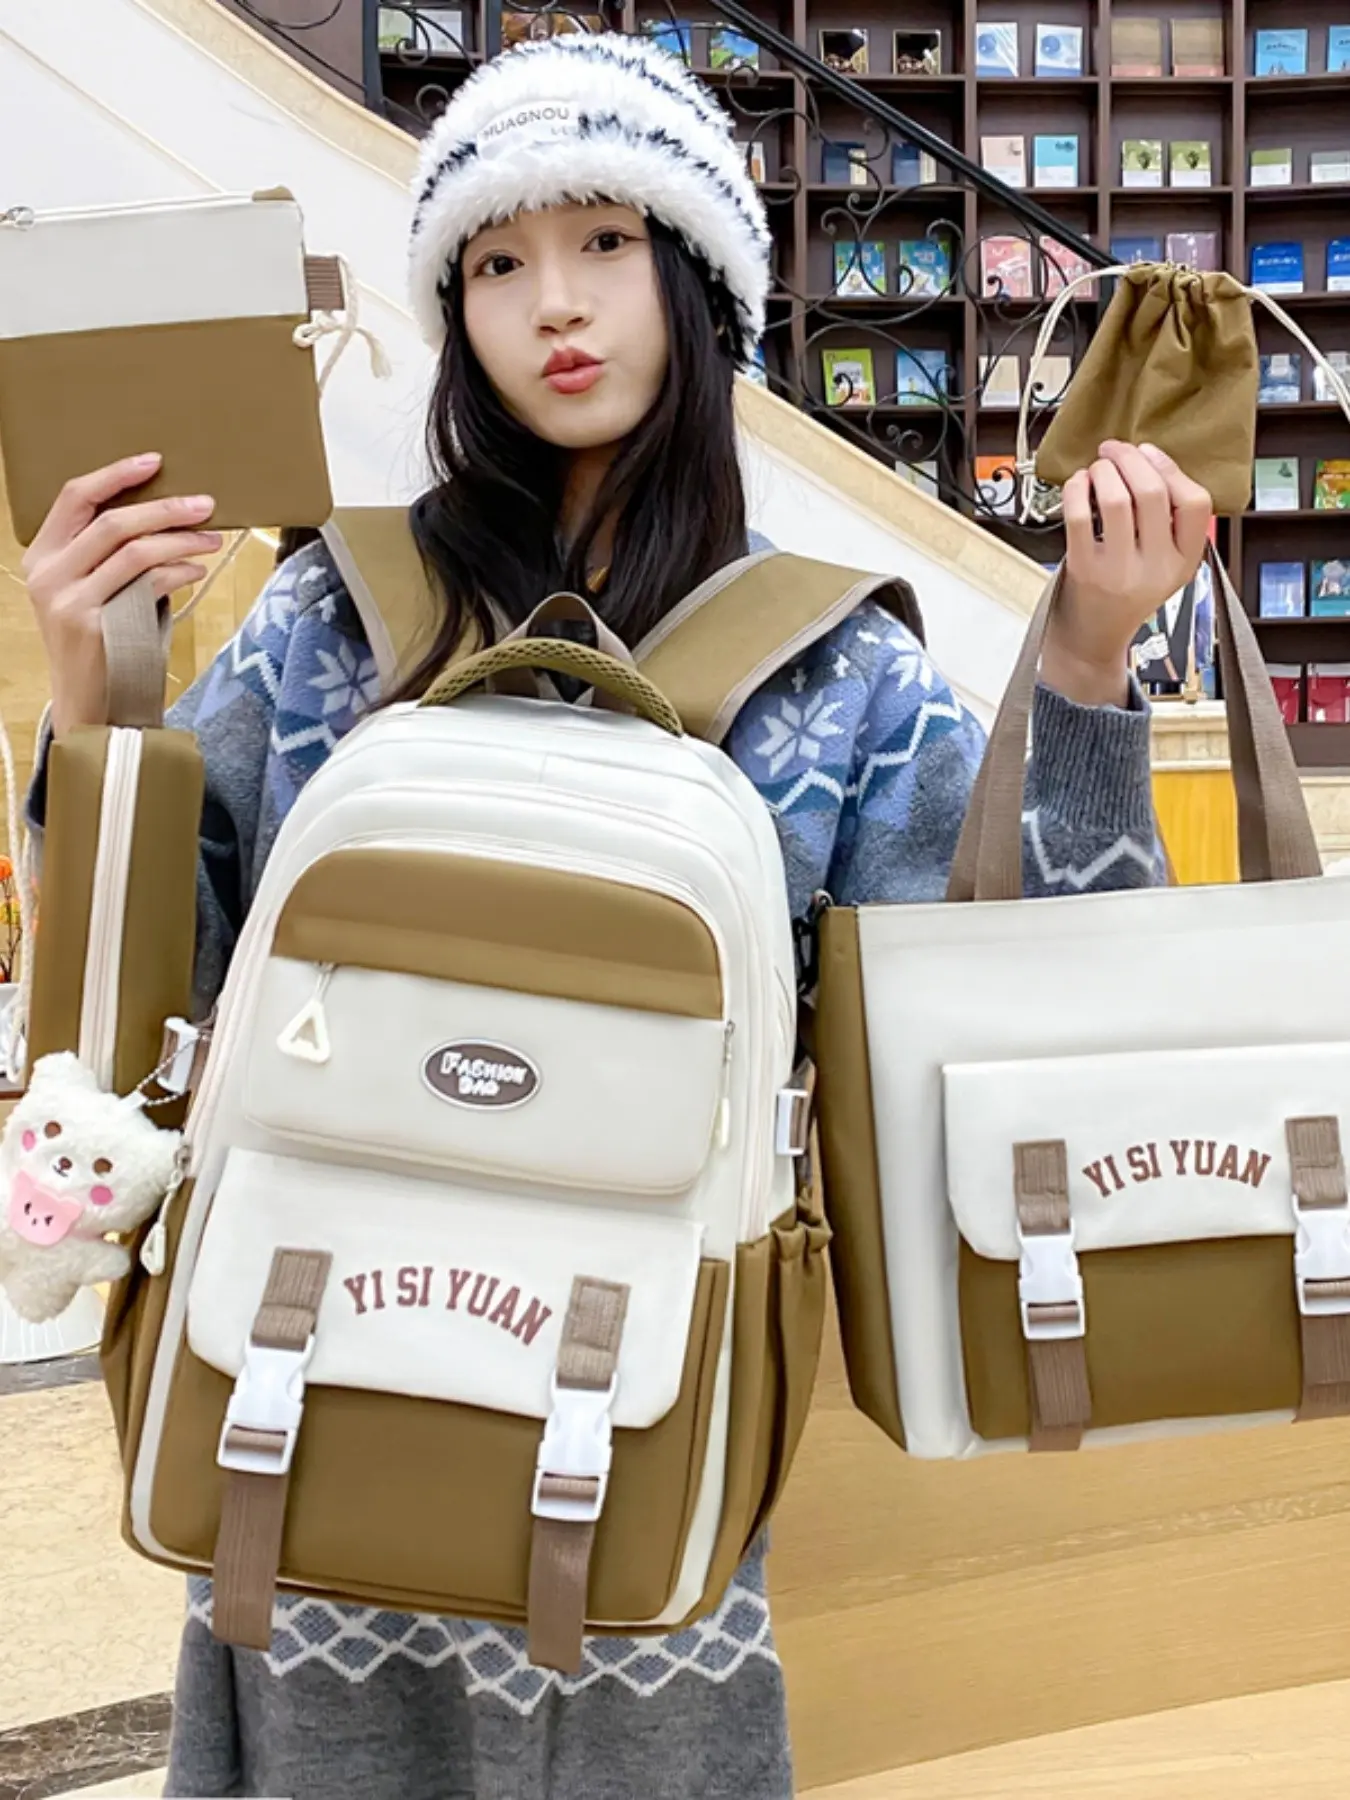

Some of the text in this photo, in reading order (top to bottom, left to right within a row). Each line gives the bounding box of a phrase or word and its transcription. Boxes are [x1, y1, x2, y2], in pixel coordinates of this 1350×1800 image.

[440, 1051, 528, 1085] FASHION
[1082, 1140, 1272, 1198] YI SI YUAN
[343, 1266, 552, 1346] YI SI YUAN
